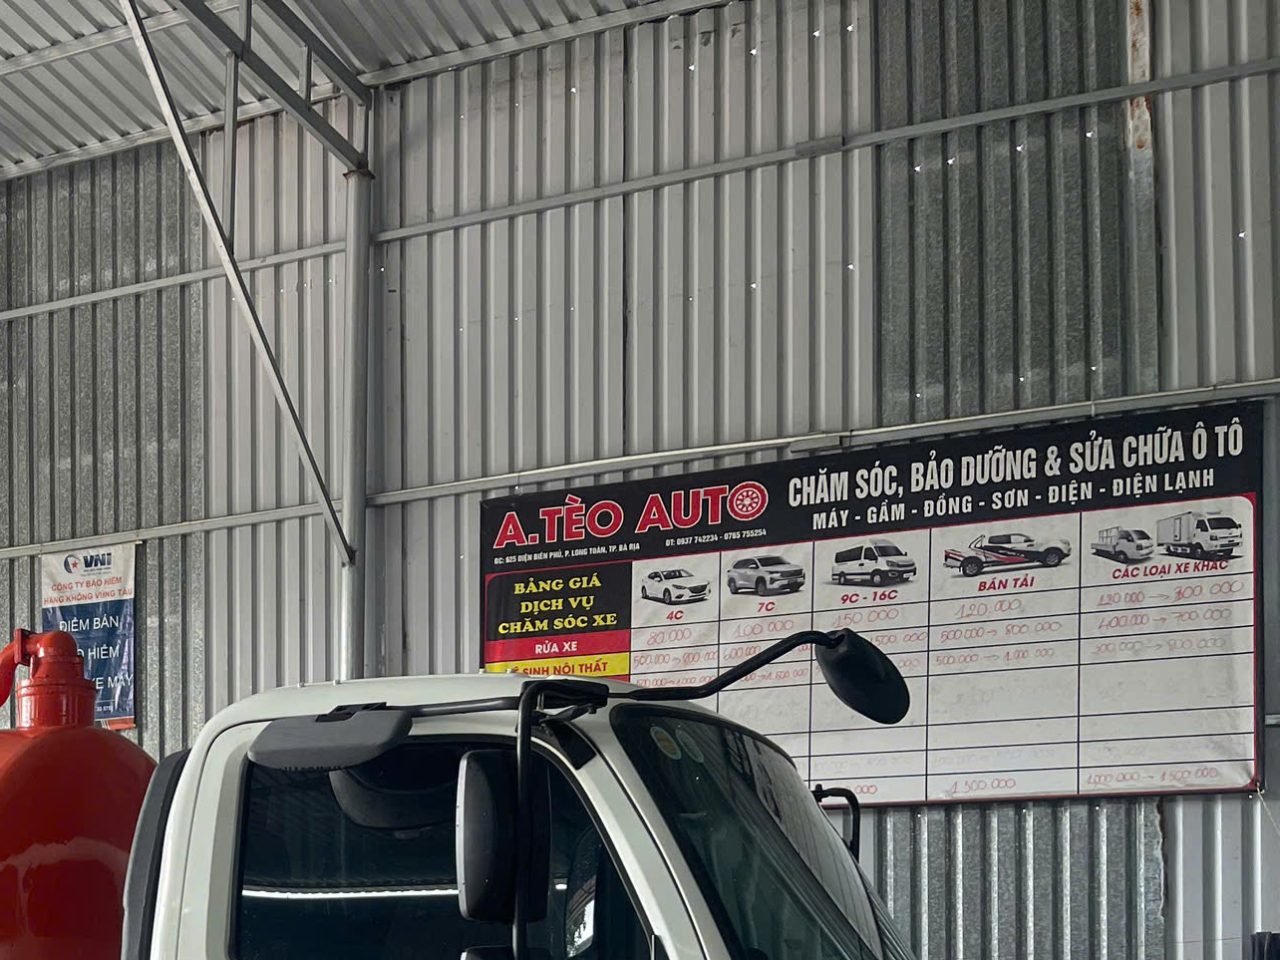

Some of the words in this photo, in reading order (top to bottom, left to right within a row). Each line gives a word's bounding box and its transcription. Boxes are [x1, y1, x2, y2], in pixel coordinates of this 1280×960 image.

[789, 468, 849, 507] CHĂM
[855, 461, 904, 499] SÓC,
[911, 450, 954, 492] BẢO
[961, 445, 1037, 486] DƯỠNG
[1045, 446, 1061, 476] &
[1069, 430, 1115, 474] SỬA
[1123, 426, 1185, 468] CHỮA
[1192, 421, 1207, 460] Ô
[1214, 417, 1243, 457] TÔ
[813, 509, 849, 530] MÁY
[867, 499, 905, 524] GẦM
[992, 489, 1028, 510] SƠN
[1048, 480, 1092, 505] ĐIỆN
[1113, 473, 1157, 498] ĐIỆN
[1165, 468, 1214, 494] LẠNH
[493, 494, 624, 549] A.TÈO
[635, 481, 769, 534] AUTO
[1112, 564, 1140, 579] CÁC
[1143, 563, 1171, 578] LOẠI
[1175, 562, 1190, 574] XE
[51, 581, 73, 592] CÔNG
[75, 580, 84, 589] TY
[514, 577, 564, 595] BẢNG
[568, 572, 602, 590] GIÁ
[978, 578, 1008, 592] BÁN
[1013, 576, 1034, 588] TẢI
[520, 598, 563, 615] DỊCH
[568, 596, 595, 611] VỤ
[841, 593, 859, 604] 9C
[872, 590, 898, 601] 16C
[666, 610, 684, 620] 4C
[757, 601, 775, 612] 7C
[93, 613, 119, 630] BÁN
[498, 618, 548, 634] CHĂM
[553, 614, 588, 630] SÓC
[592, 613, 617, 627] XE
[535, 640, 559, 654] RỬA
[562, 641, 577, 652] XE
[578, 657, 608, 673] THẤT
